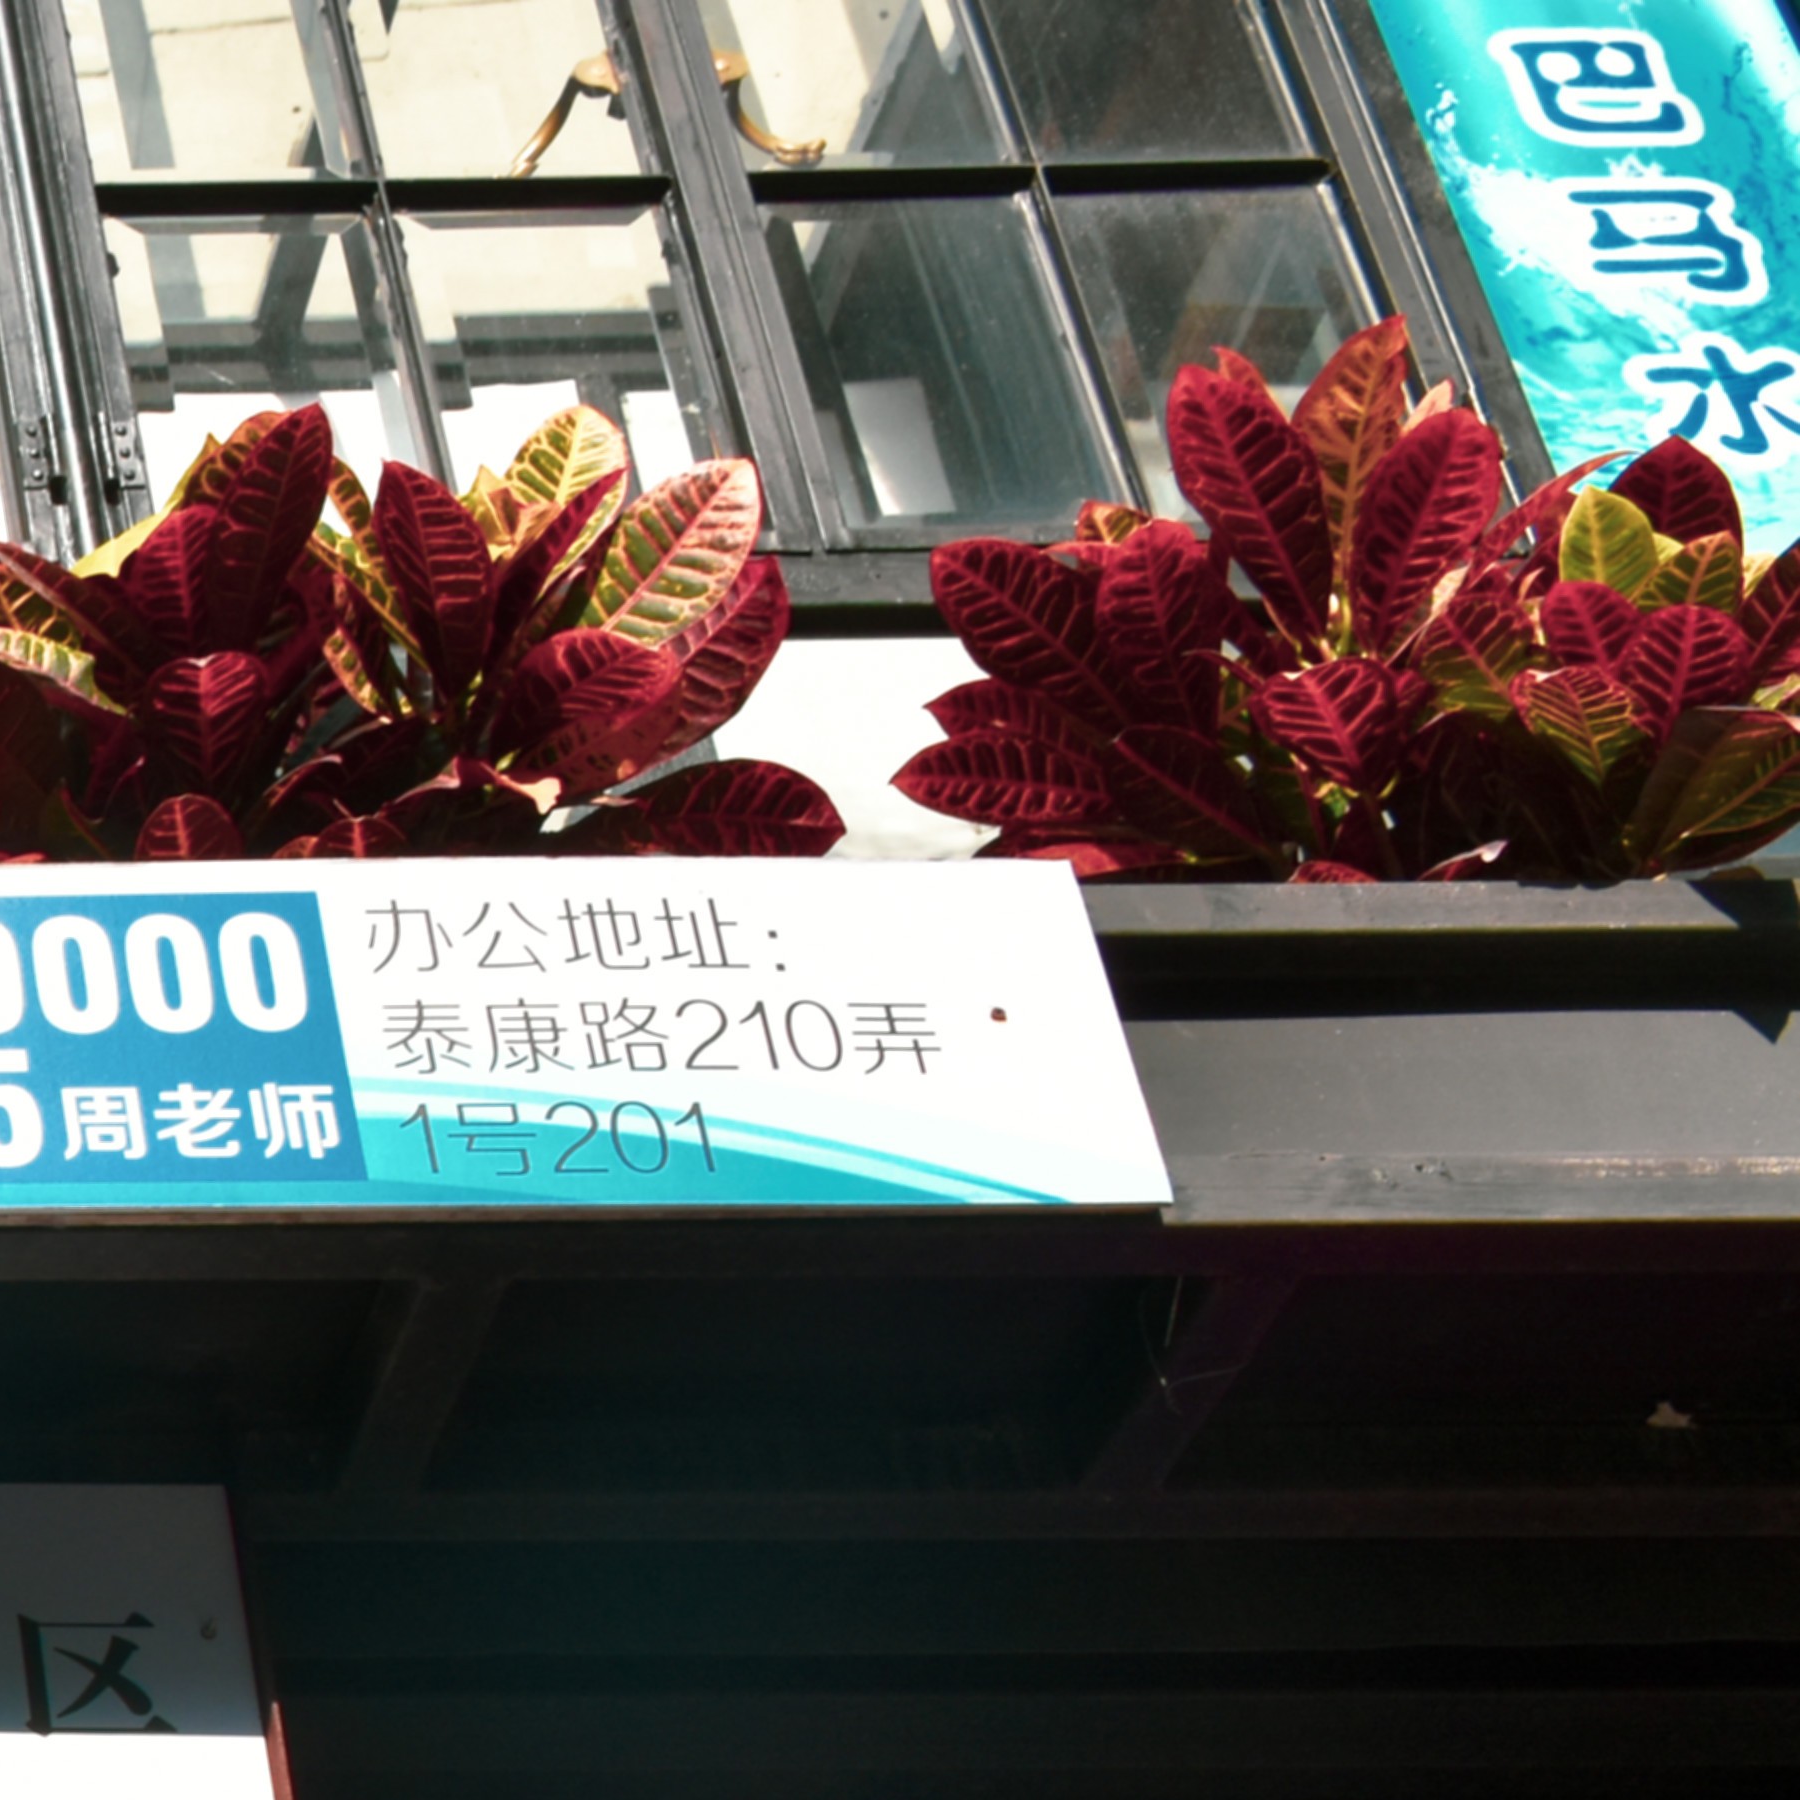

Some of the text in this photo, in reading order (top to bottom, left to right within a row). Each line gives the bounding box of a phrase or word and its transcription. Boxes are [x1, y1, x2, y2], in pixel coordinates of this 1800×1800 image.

[382, 996, 942, 1076] 泰康路210弄
[59, 1080, 342, 1163] 周老师
[398, 1100, 717, 1177] 1号201
